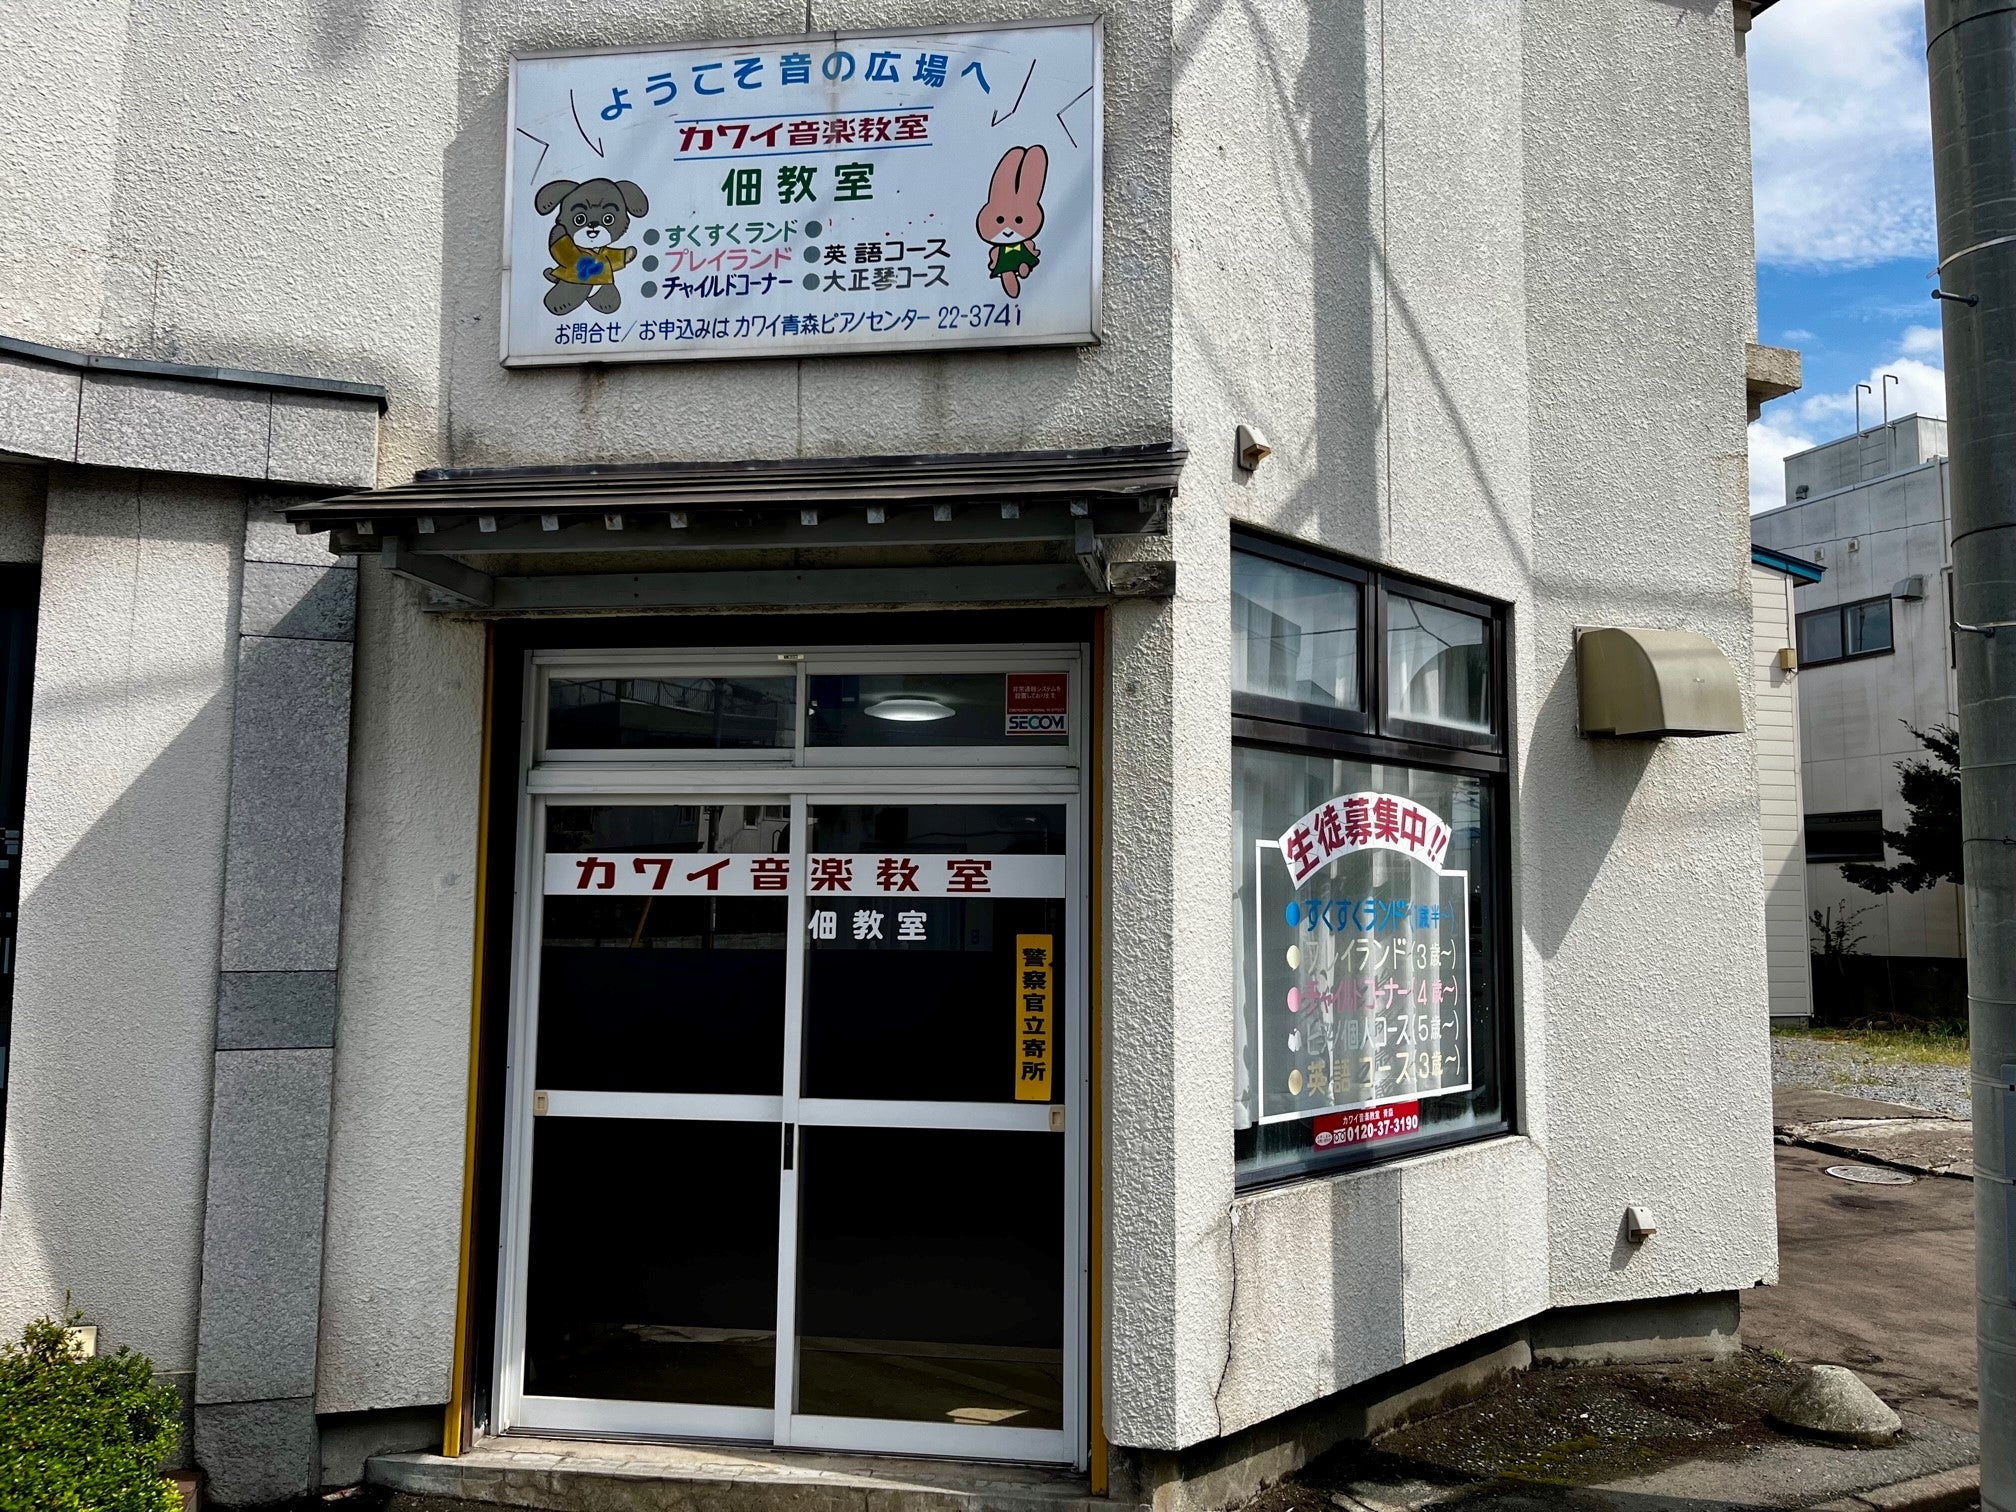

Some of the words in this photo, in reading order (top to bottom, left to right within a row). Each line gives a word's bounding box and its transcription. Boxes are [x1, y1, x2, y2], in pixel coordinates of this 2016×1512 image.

[600, 51, 991, 121] ようこそ音の広場へ
[679, 114, 929, 152] カワイ音楽教室
[722, 162, 875, 206] 佃教室
[665, 219, 798, 248] すくすくランド
[665, 247, 793, 273] プレイランド
[823, 239, 951, 265] 英語コース
[662, 272, 793, 300] チャイルドコーナー
[823, 265, 950, 293] 大正琴コース
[938, 304, 1022, 330] 22-3741
[1009, 715, 1064, 729] SECOM
[576, 857, 992, 892] カワイ音楽教室
[808, 909, 927, 941] 佃教室
[1021, 948, 1047, 1081] 警察官立寄所
[1347, 1114, 1418, 1142] 0120-37-3190
